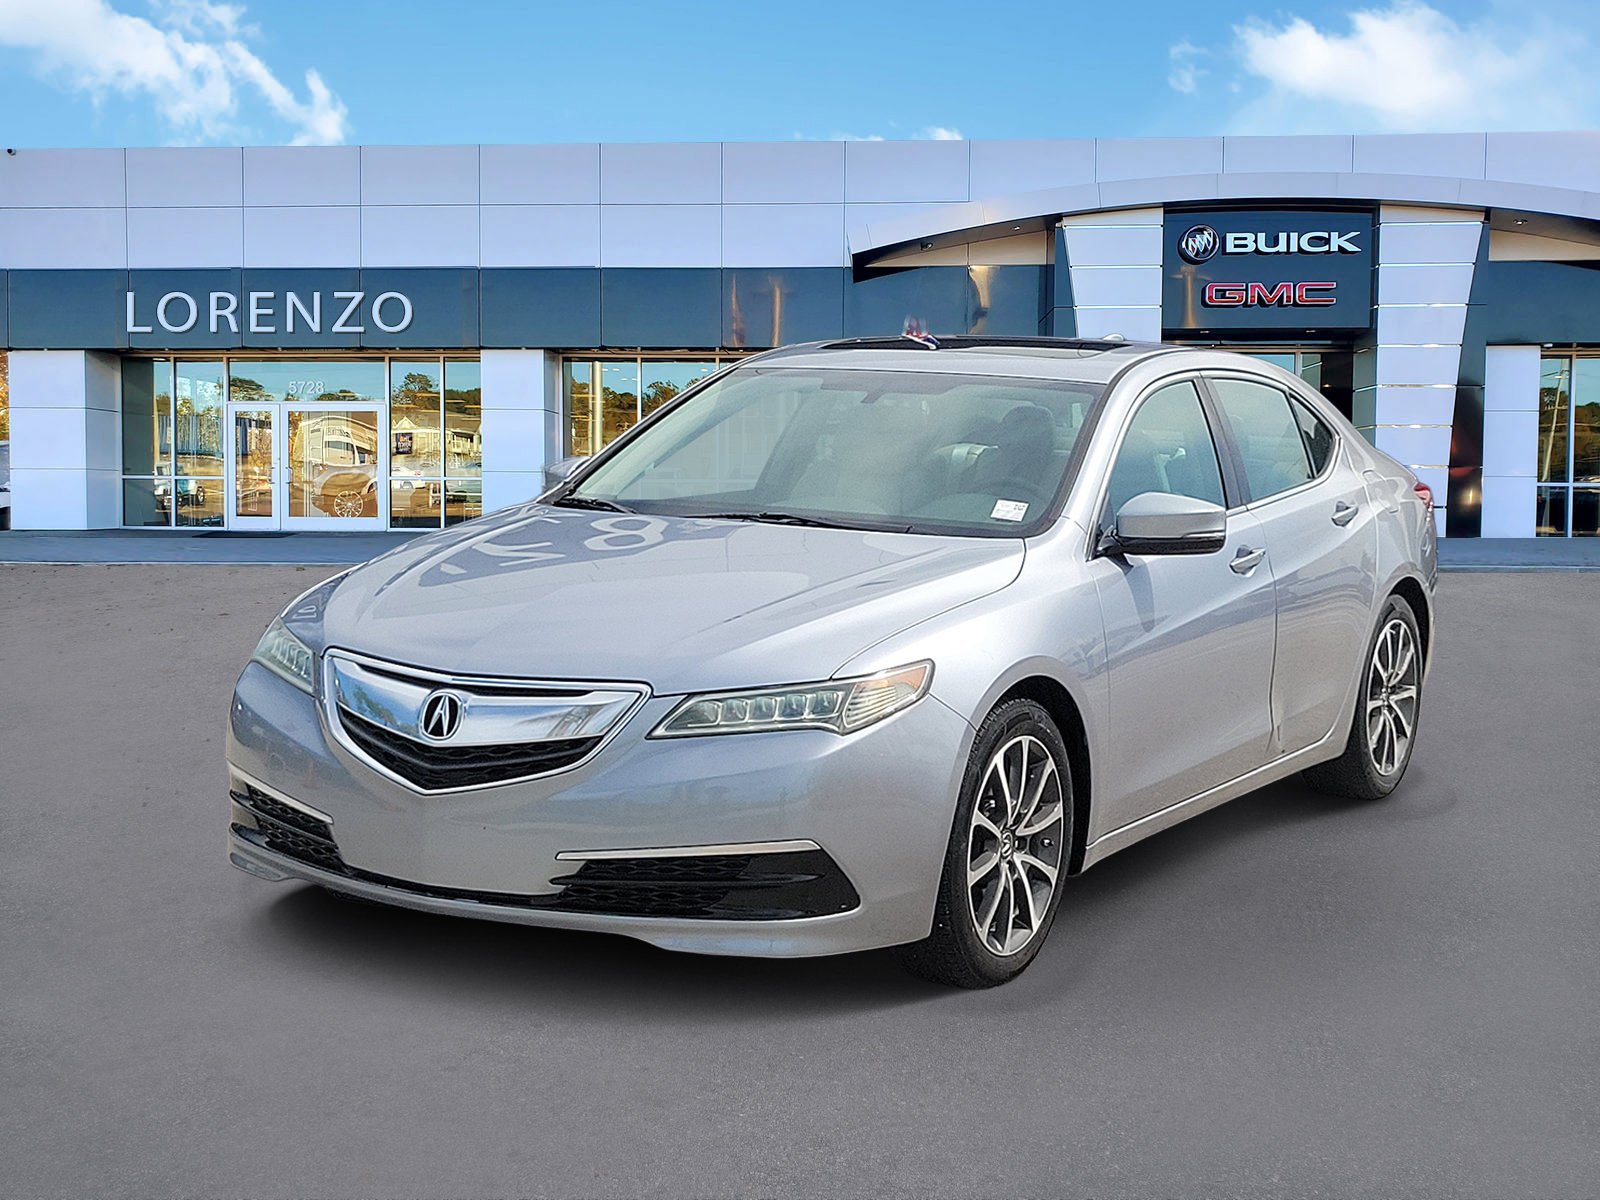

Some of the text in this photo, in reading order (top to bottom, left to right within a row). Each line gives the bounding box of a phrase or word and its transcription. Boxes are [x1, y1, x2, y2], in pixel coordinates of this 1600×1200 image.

[1225, 231, 1362, 253] BUICK
[1205, 281, 1337, 305] GMC
[126, 291, 414, 333] LORENZO
[288, 380, 325, 394] 5728
